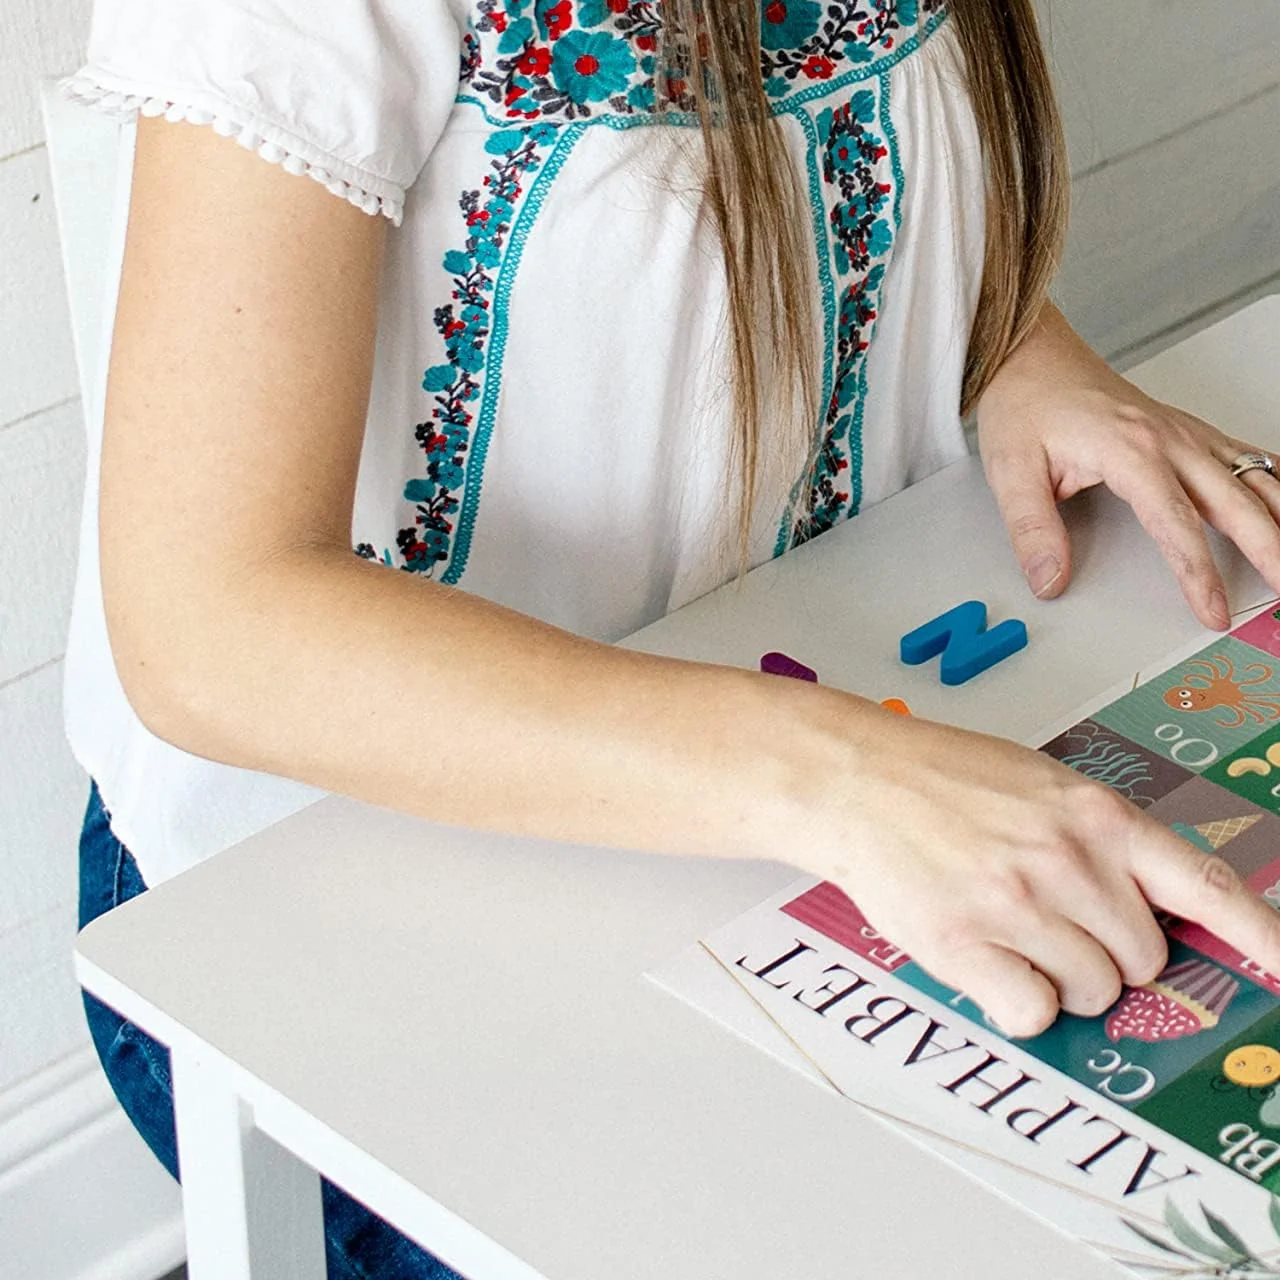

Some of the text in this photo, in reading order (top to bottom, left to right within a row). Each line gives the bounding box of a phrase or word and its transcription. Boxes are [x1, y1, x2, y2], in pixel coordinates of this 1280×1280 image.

[1154, 722, 1218, 767] Oo
[735, 938, 1202, 1198] ALPHABET
[1087, 1049, 1156, 1102] Cc
